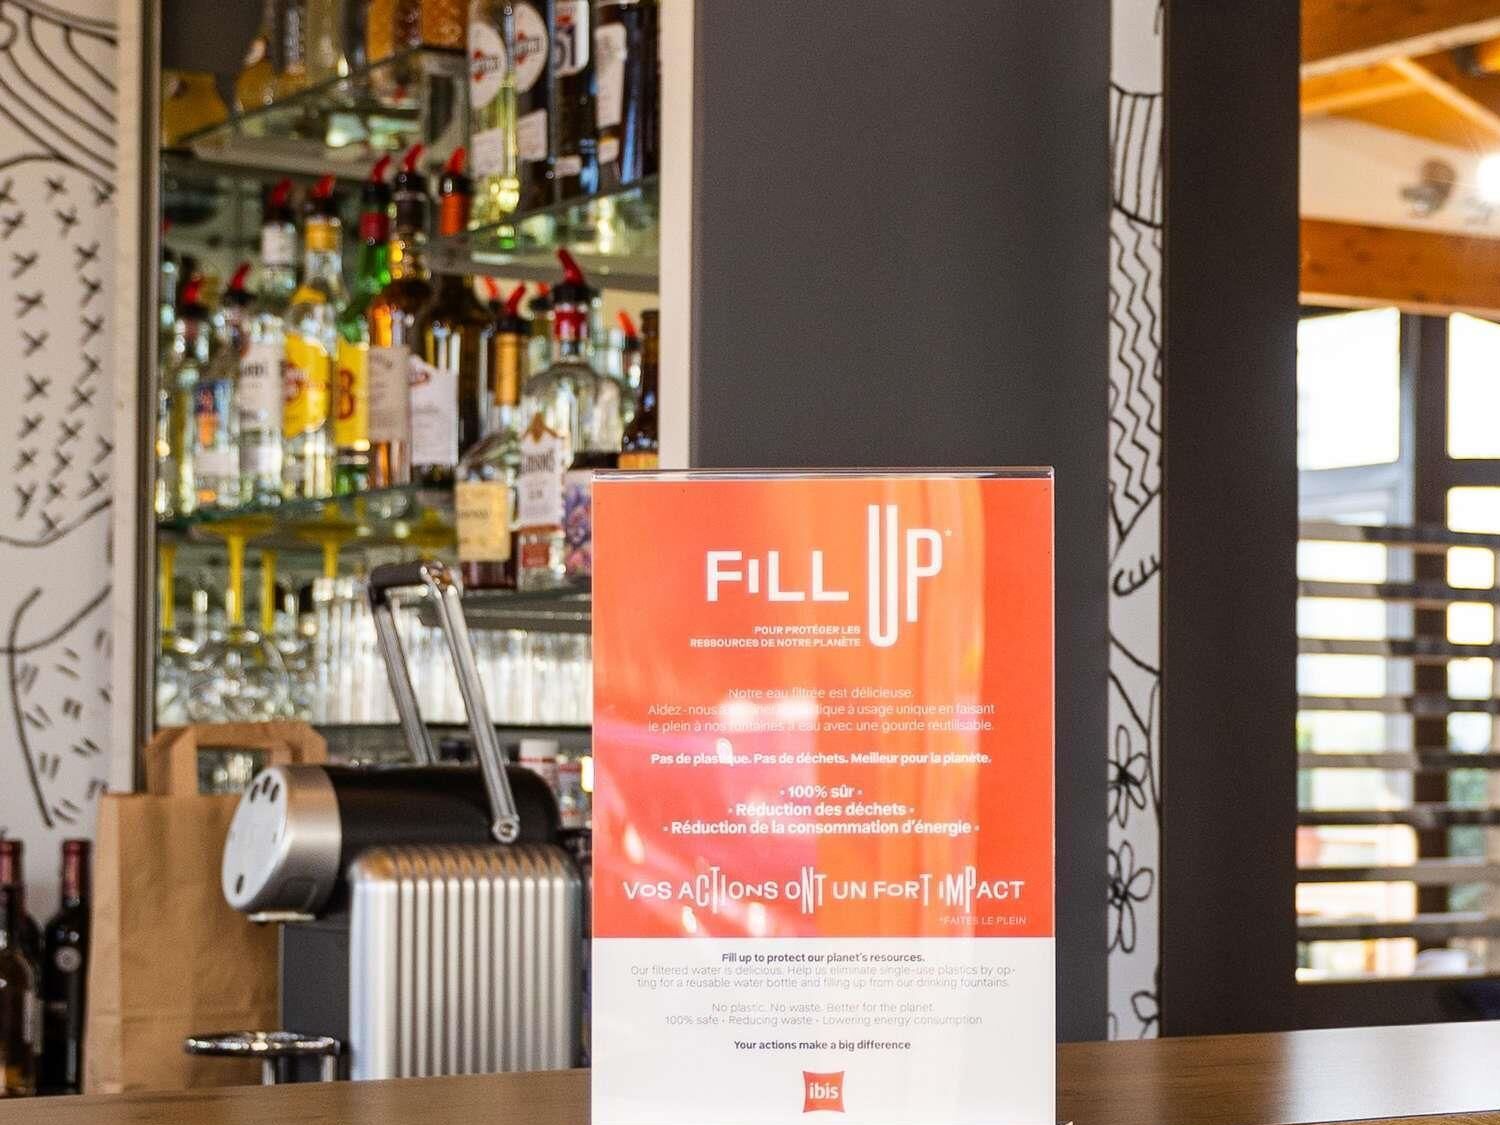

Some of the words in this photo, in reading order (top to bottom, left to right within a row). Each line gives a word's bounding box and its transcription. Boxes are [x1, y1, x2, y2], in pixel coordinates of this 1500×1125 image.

[753, 625, 783, 635] POUR
[785, 622, 840, 635] PROTÉGER
[841, 625, 861, 635] LES
[690, 638, 759, 648] RESSOURCES
[761, 638, 776, 648] DE
[778, 638, 812, 648] NOTRE
[813, 635, 861, 648] PLANÈTE
[728, 688, 763, 699] Notre
[766, 690, 786, 699] eau
[788, 687, 825, 699] filtrée
[829, 689, 848, 698] est
[857, 706, 894, 719] usage
[896, 704, 937, 719] unique
[940, 706, 953, 715] en
[954, 703, 996, 715] faisant
[648, 720, 660, 732] le
[662, 720, 691, 735] plein
[693, 720, 702, 732] à
[704, 723, 728, 732] nos
[824, 722, 853, 732] avec
[856, 723, 880, 732] une
[881, 720, 925, 735] gourde
[650, 753, 674, 765] Pas
[676, 753, 692, 765] de
[754, 753, 777, 765] Pas
[778, 753, 794, 765] de
[796, 752, 849, 764] déchets.
[850, 752, 898, 764] Meilleur
[900, 755, 928, 767] pour
[930, 752, 941, 764] la
[943, 752, 992, 767] planète.
[787, 785, 828, 798] 100%
[831, 783, 855, 798] sûr
[735, 802, 812, 816] Réduction
[815, 803, 843, 816] des
[845, 802, 907, 816] déchets
[671, 820, 747, 834] Réduction
[750, 821, 769, 834] de
[771, 821, 785, 834] la
[787, 820, 899, 833] consommation
[902, 819, 972, 837] d'énergie
[678, 866, 779, 915] ACTIONS
[784, 866, 828, 915] ONT
[832, 880, 866, 899] UN
[938, 865, 1025, 914] IMPACT
[981, 916, 994, 925] LE
[996, 916, 1027, 926] PLEIN
[722, 952, 737, 963] Fill
[739, 955, 752, 966] up
[754, 954, 765, 963] to
[767, 953, 805, 966] protect
[807, 955, 825, 963] our
[826, 952, 868, 966] planet's
[870, 955, 925, 963] resources.
[631, 966, 649, 976] Our
[652, 965, 689, 976] filtered
[691, 967, 721, 976] water
[725, 966, 733, 976] is
[788, 965, 811, 978] Help
[815, 967, 828, 976] us
[830, 965, 878, 976] eliminate
[938, 965, 978, 979] plastics
[980, 965, 994, 979] by
[637, 978, 657, 991] ting
[660, 977, 675, 988] for
[677, 980, 684, 988] a
[686, 977, 731, 988] reusable
[734, 979, 764, 988] water
[767, 977, 798, 988] bottle
[800, 978, 821, 988] and
[823, 977, 850, 991] filling
[853, 979, 866, 991] up
[869, 977, 893, 988] from
[896, 979, 914, 988] our
[916, 977, 958, 991] drinking
[712, 1003, 728, 1013] No
[770, 1003, 786, 1013] No
[826, 1002, 859, 1013] Better
[862, 1002, 877, 1013] for
[880, 1003, 897, 1013] the
[665, 1015, 694, 1025] 100%
[696, 1015, 719, 1025] safe
[728, 1015, 778, 1027] Reducing
[780, 1017, 813, 1025] waste
[822, 1015, 871, 1027] Lowering
[874, 1018, 911, 1029] energy
[913, 1015, 983, 1028] consumption
[734, 1040, 757, 1050] Your
[759, 1040, 797, 1050] actions
[799, 1039, 829, 1050] make
[830, 1042, 836, 1050] a
[838, 1039, 855, 1053] big
[857, 1039, 912, 1050] difference
[808, 1081, 840, 1100] ibis
